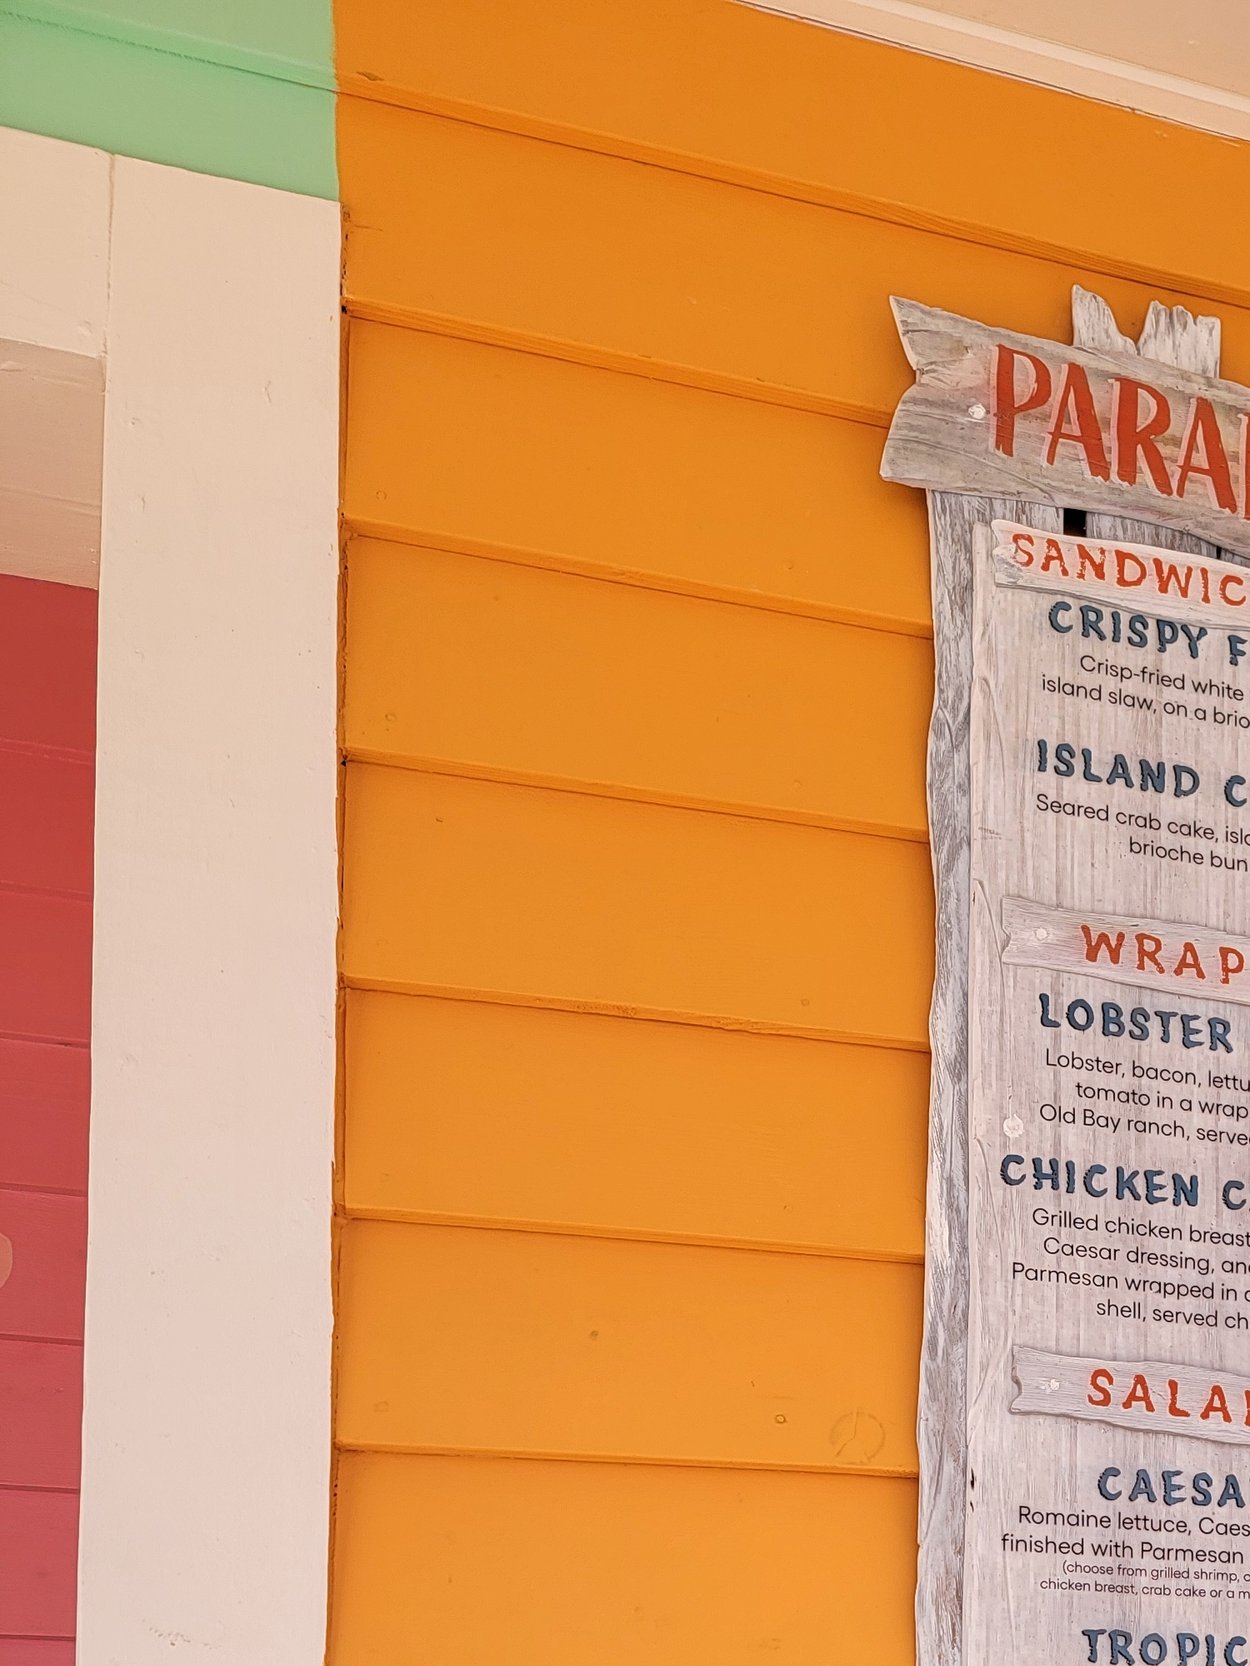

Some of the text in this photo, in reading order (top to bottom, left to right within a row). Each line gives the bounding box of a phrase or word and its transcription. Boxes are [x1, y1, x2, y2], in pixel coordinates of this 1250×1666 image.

[1048, 601, 1208, 659] CRISPY
[1080, 654, 1185, 690] Crisp-fried
[1191, 678, 1244, 701] white
[1037, 739, 1200, 798] ISLAND
[1036, 793, 1109, 822] Seared
[1115, 811, 1162, 831] crab
[1167, 820, 1219, 843] cake,
[1038, 993, 1233, 1054] LOBSTER
[1046, 1048, 1125, 1078] Lobster,
[1132, 1059, 1202, 1088] bacon,
[999, 1154, 1199, 1207] CHICKEN
[1032, 1207, 1098, 1231] Grilled
[1104, 1216, 1182, 1240] chicken
[1000, 1533, 1084, 1555] finished
[1090, 1539, 1134, 1558] with
[1140, 1541, 1244, 1564] Parmesan
